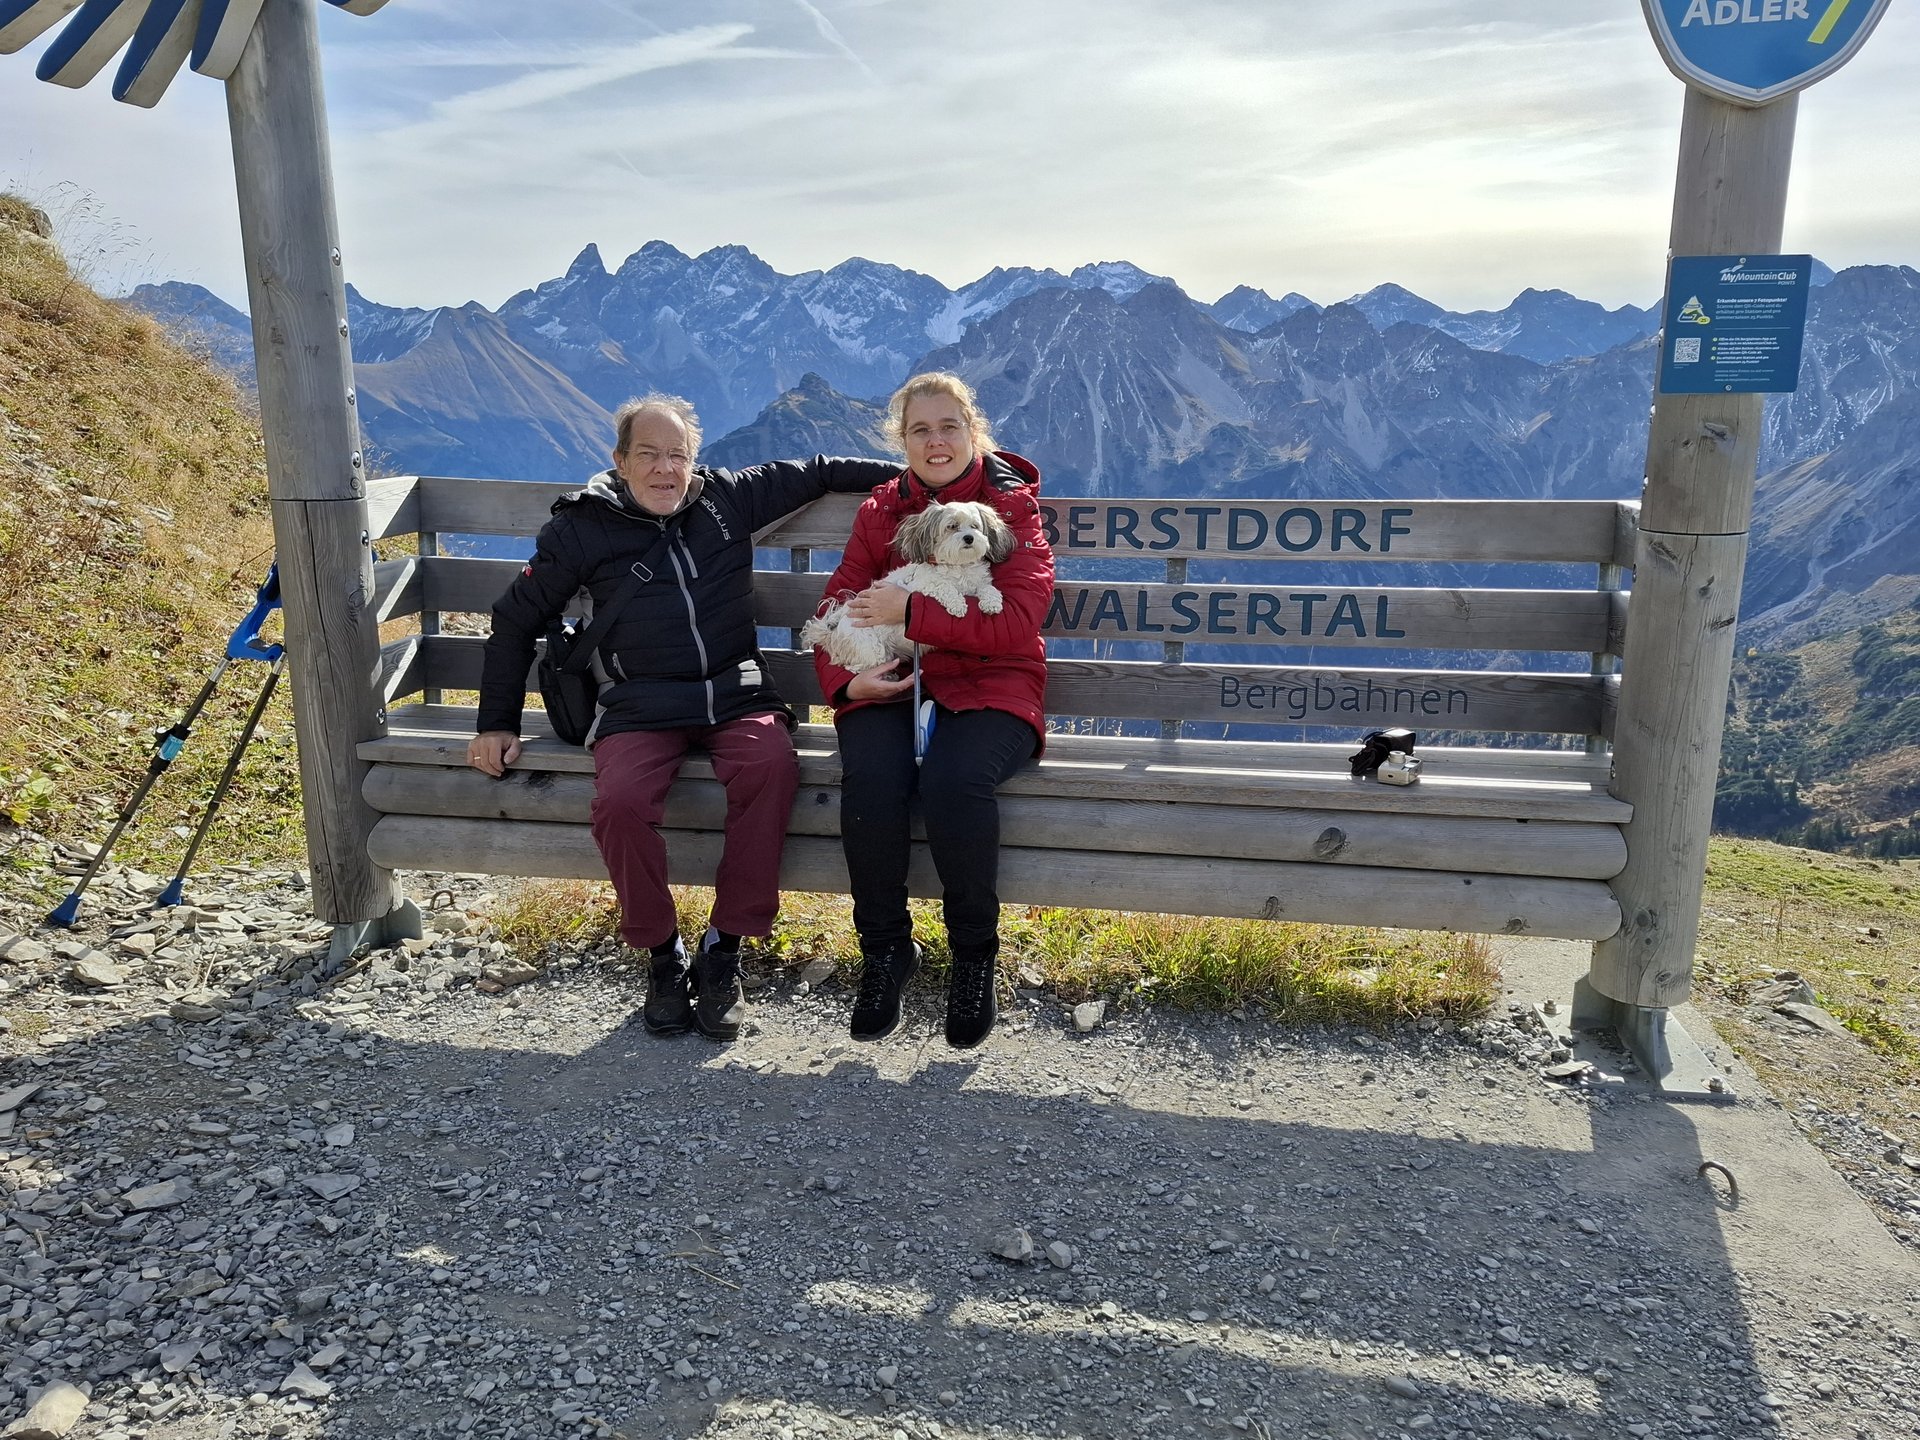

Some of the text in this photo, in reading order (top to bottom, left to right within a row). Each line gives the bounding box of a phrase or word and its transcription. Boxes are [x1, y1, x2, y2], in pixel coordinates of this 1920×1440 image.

[1680, 0, 1810, 27] ADLER
[1720, 272, 1797, 282] MyMountainClub
[1042, 589, 1406, 638] WALSERTAL
[1219, 675, 1469, 719] Bergbahnen
